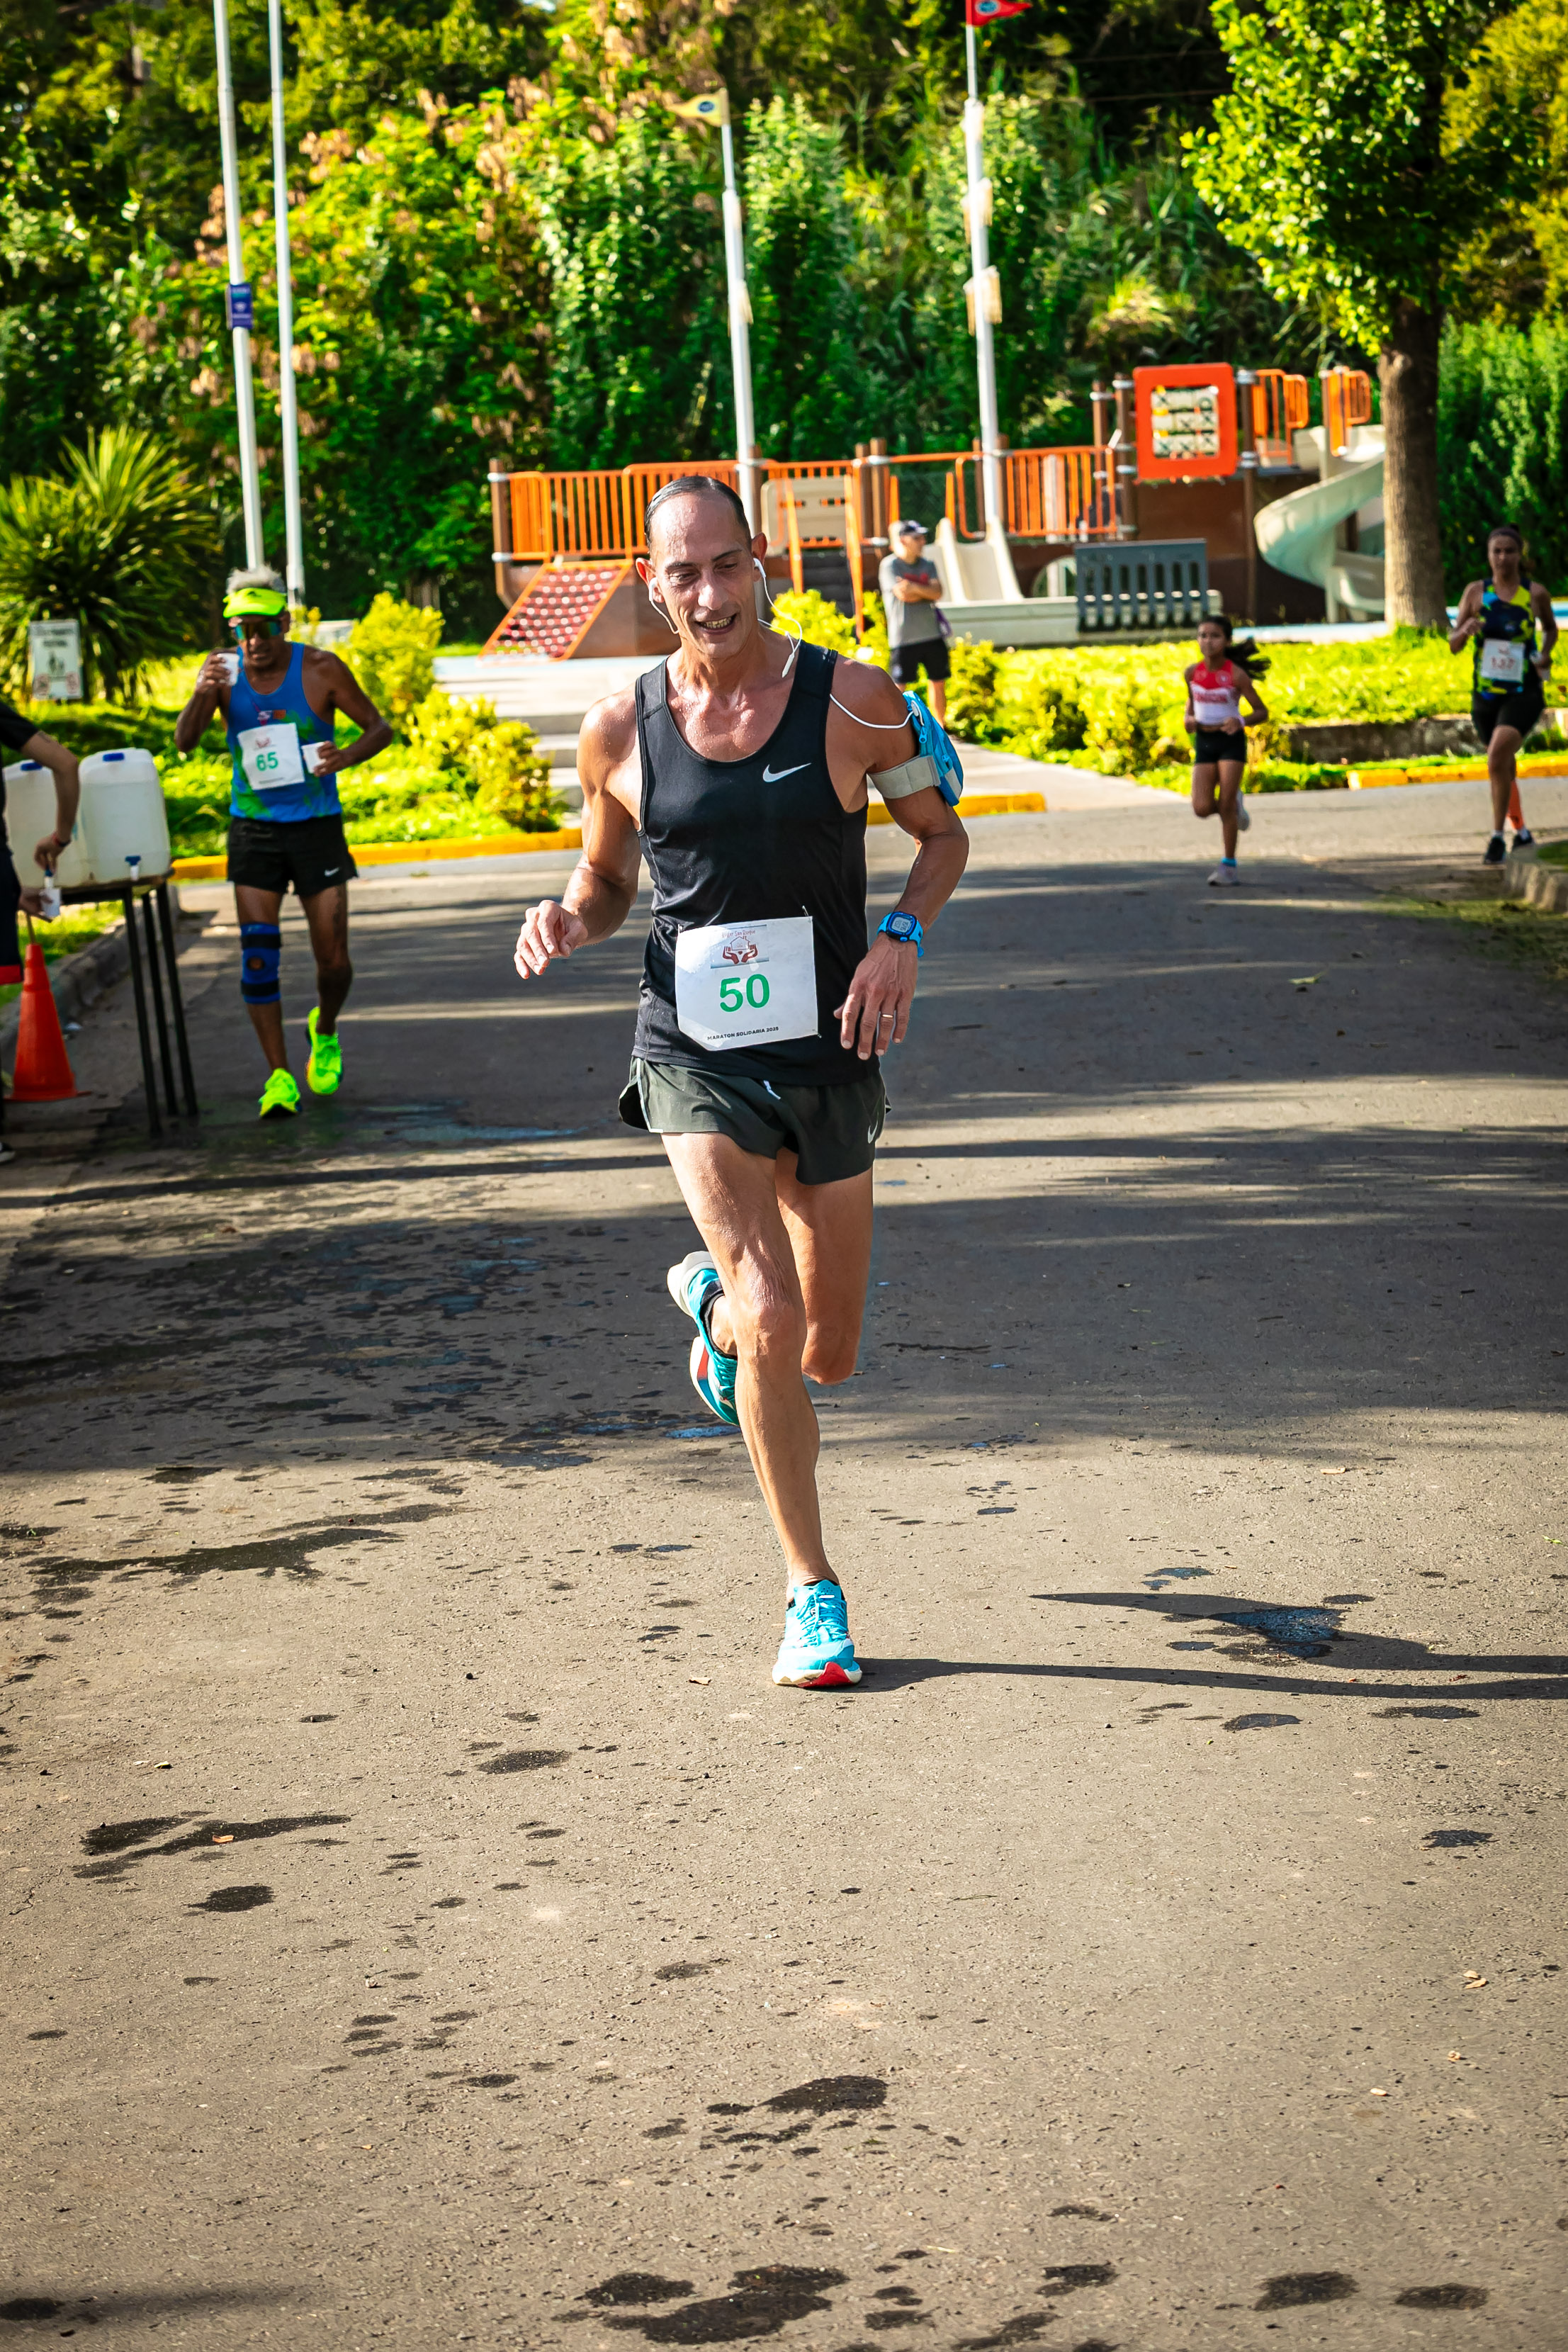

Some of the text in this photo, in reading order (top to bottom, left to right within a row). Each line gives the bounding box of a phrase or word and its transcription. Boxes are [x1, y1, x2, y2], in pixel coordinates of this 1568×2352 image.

[256, 751, 278, 771] 65
[720, 974, 770, 1013] 50
[736, 1028, 765, 1037] SOLIDARIA
